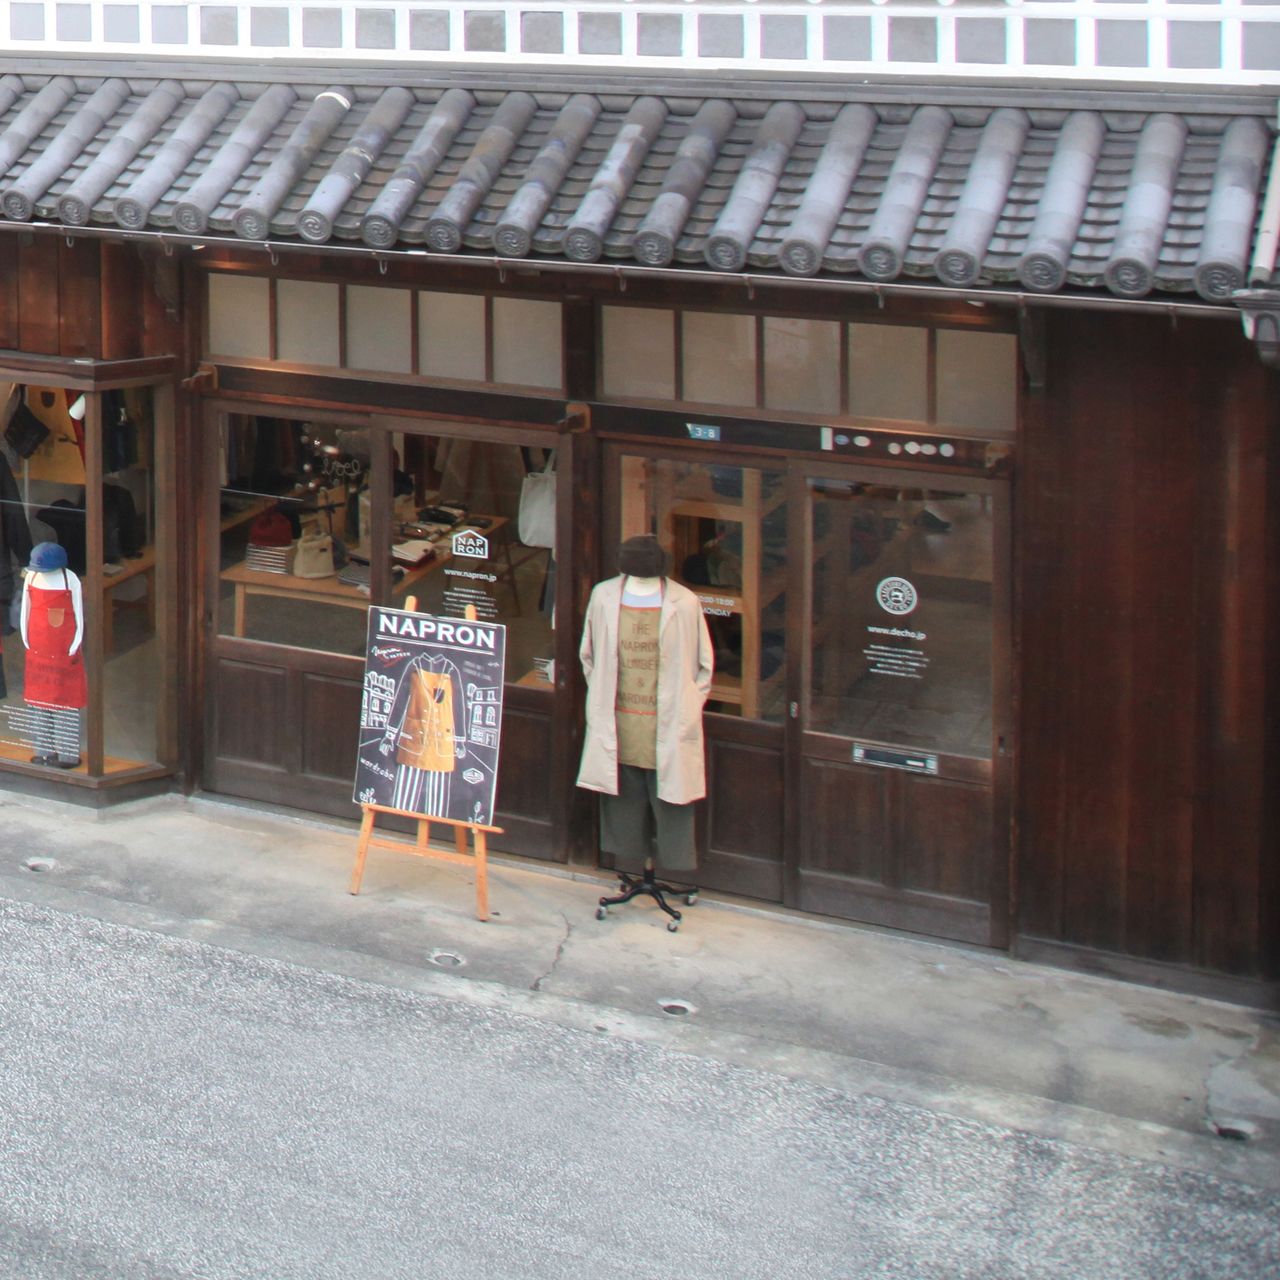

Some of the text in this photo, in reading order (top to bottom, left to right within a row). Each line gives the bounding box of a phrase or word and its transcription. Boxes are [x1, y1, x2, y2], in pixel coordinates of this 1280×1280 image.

[695, 426, 716, 438] 3-8
[457, 536, 484, 547] NAP
[457, 545, 484, 555] RON
[443, 568, 497, 583] www.napron.jp
[378, 614, 496, 649] NAPRON
[631, 623, 651, 636] THE
[866, 625, 927, 641] www.decho.jp
[360, 757, 395, 781] wardrobe
